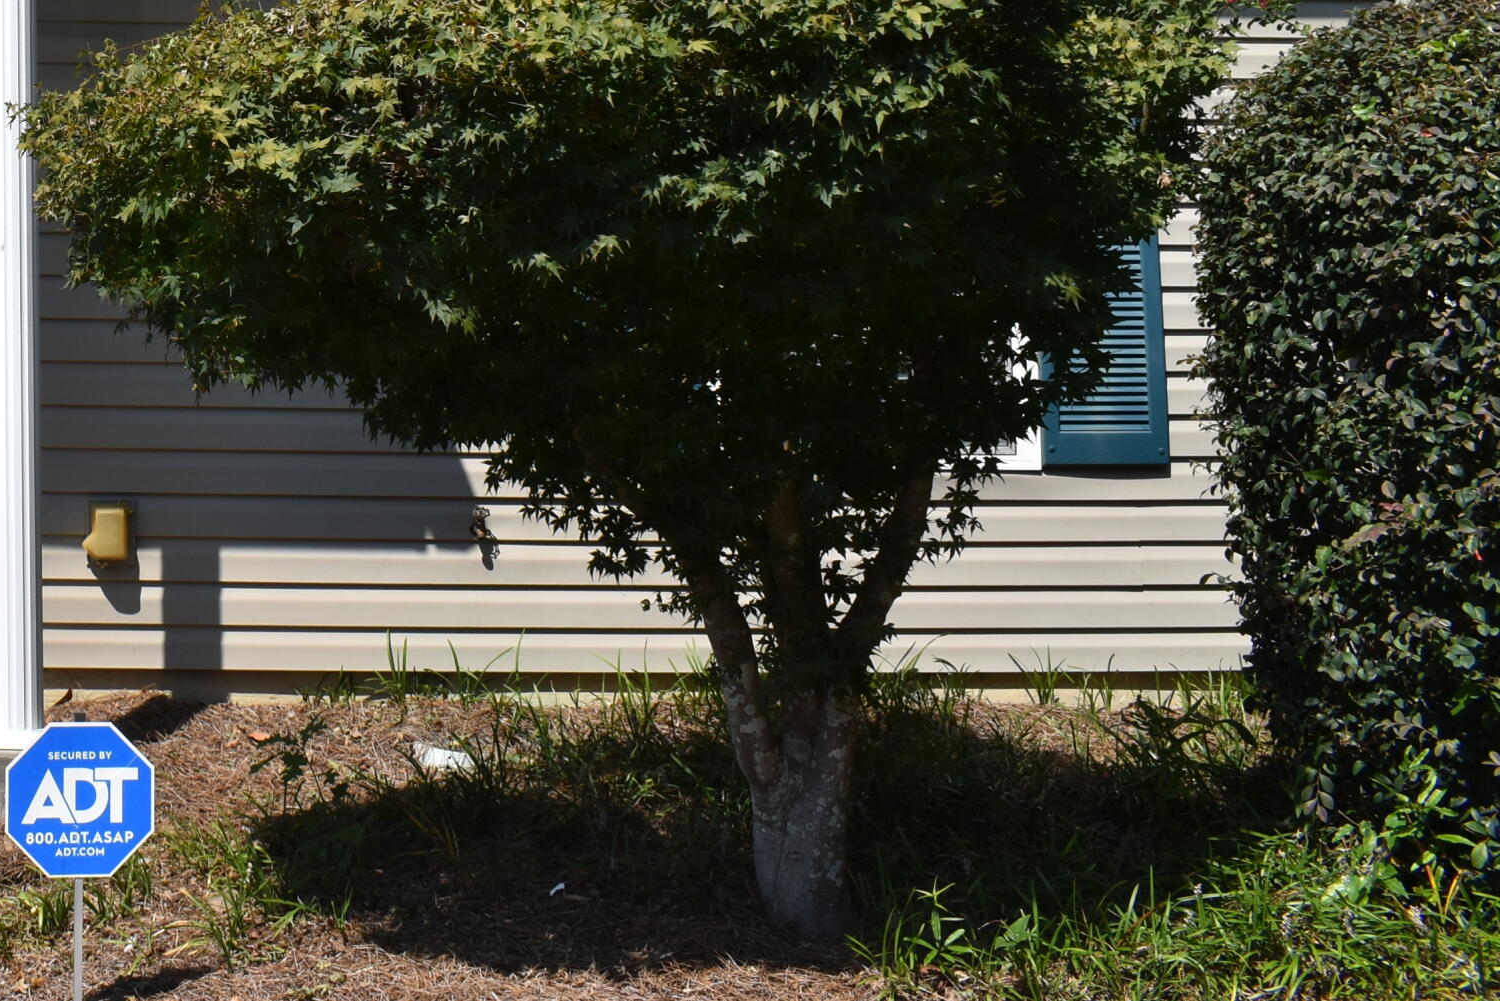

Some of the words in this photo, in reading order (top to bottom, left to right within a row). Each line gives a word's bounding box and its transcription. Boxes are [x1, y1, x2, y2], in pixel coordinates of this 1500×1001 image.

[47, 751, 96, 760] SECURED
[99, 751, 112, 760] BY
[20, 767, 139, 825] ADT
[25, 831, 134, 845] 800.ADT.ASAP
[55, 847, 105, 857] ADT.COM
